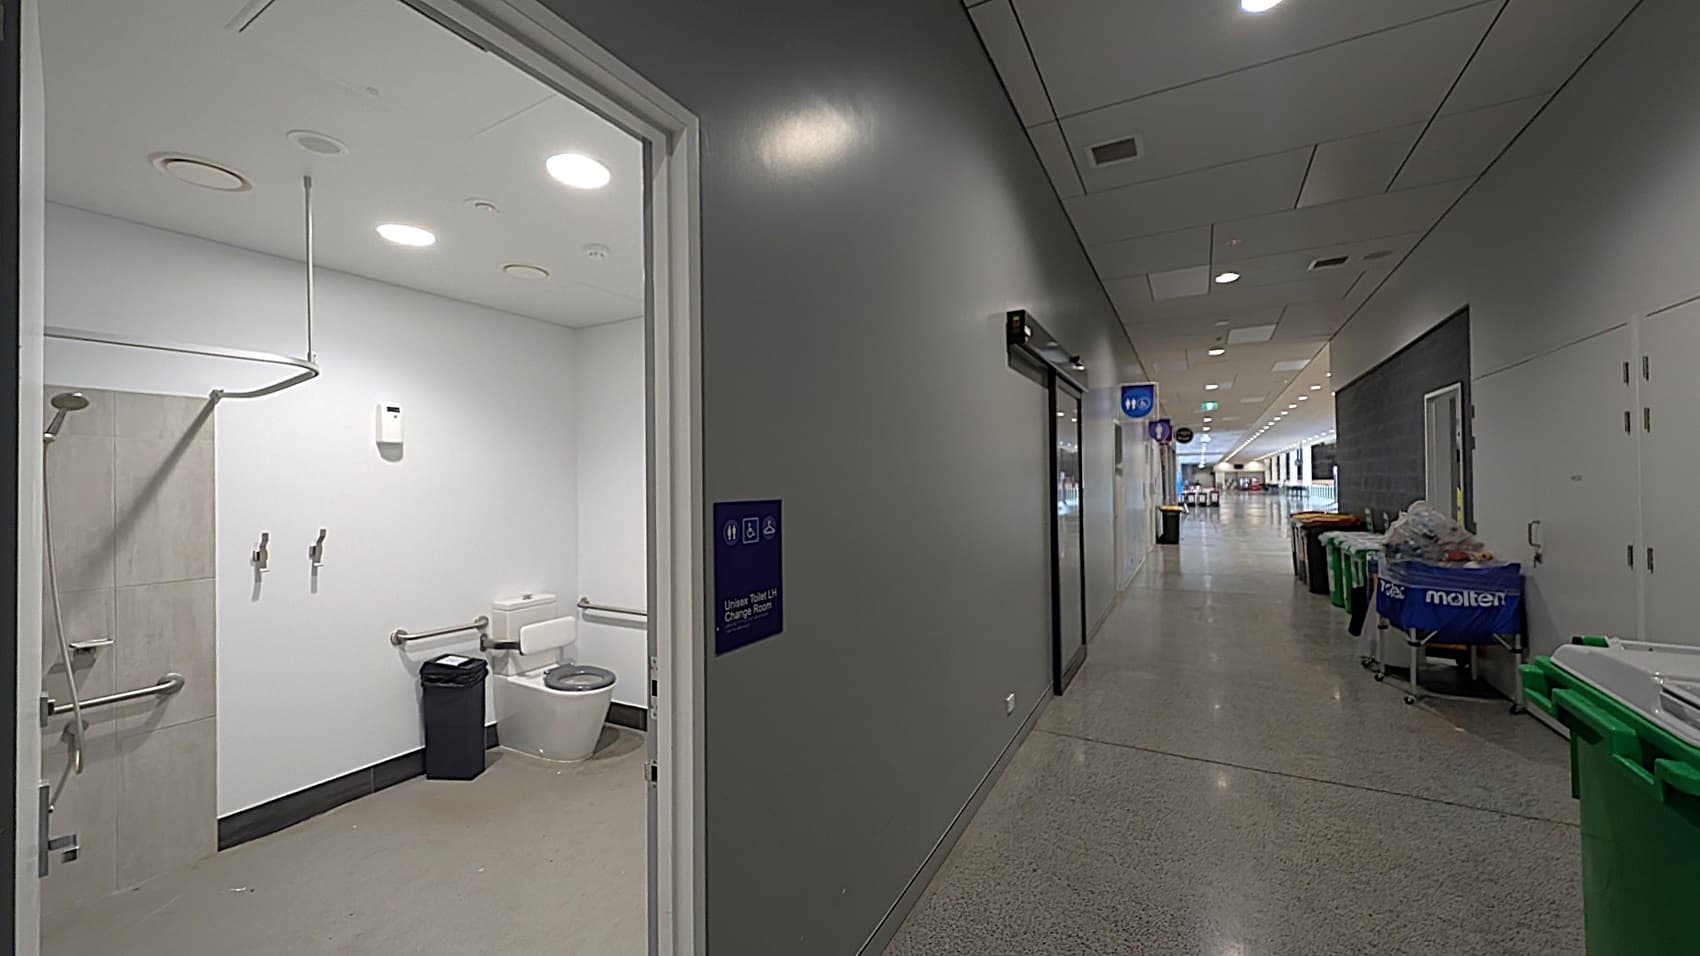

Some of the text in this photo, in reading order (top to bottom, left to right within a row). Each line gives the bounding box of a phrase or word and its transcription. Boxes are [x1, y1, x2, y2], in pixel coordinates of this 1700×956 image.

[724, 588, 777, 611] Unisex Toilet LH
[1426, 590, 1506, 607] molten
[724, 602, 772, 622] Change Room
